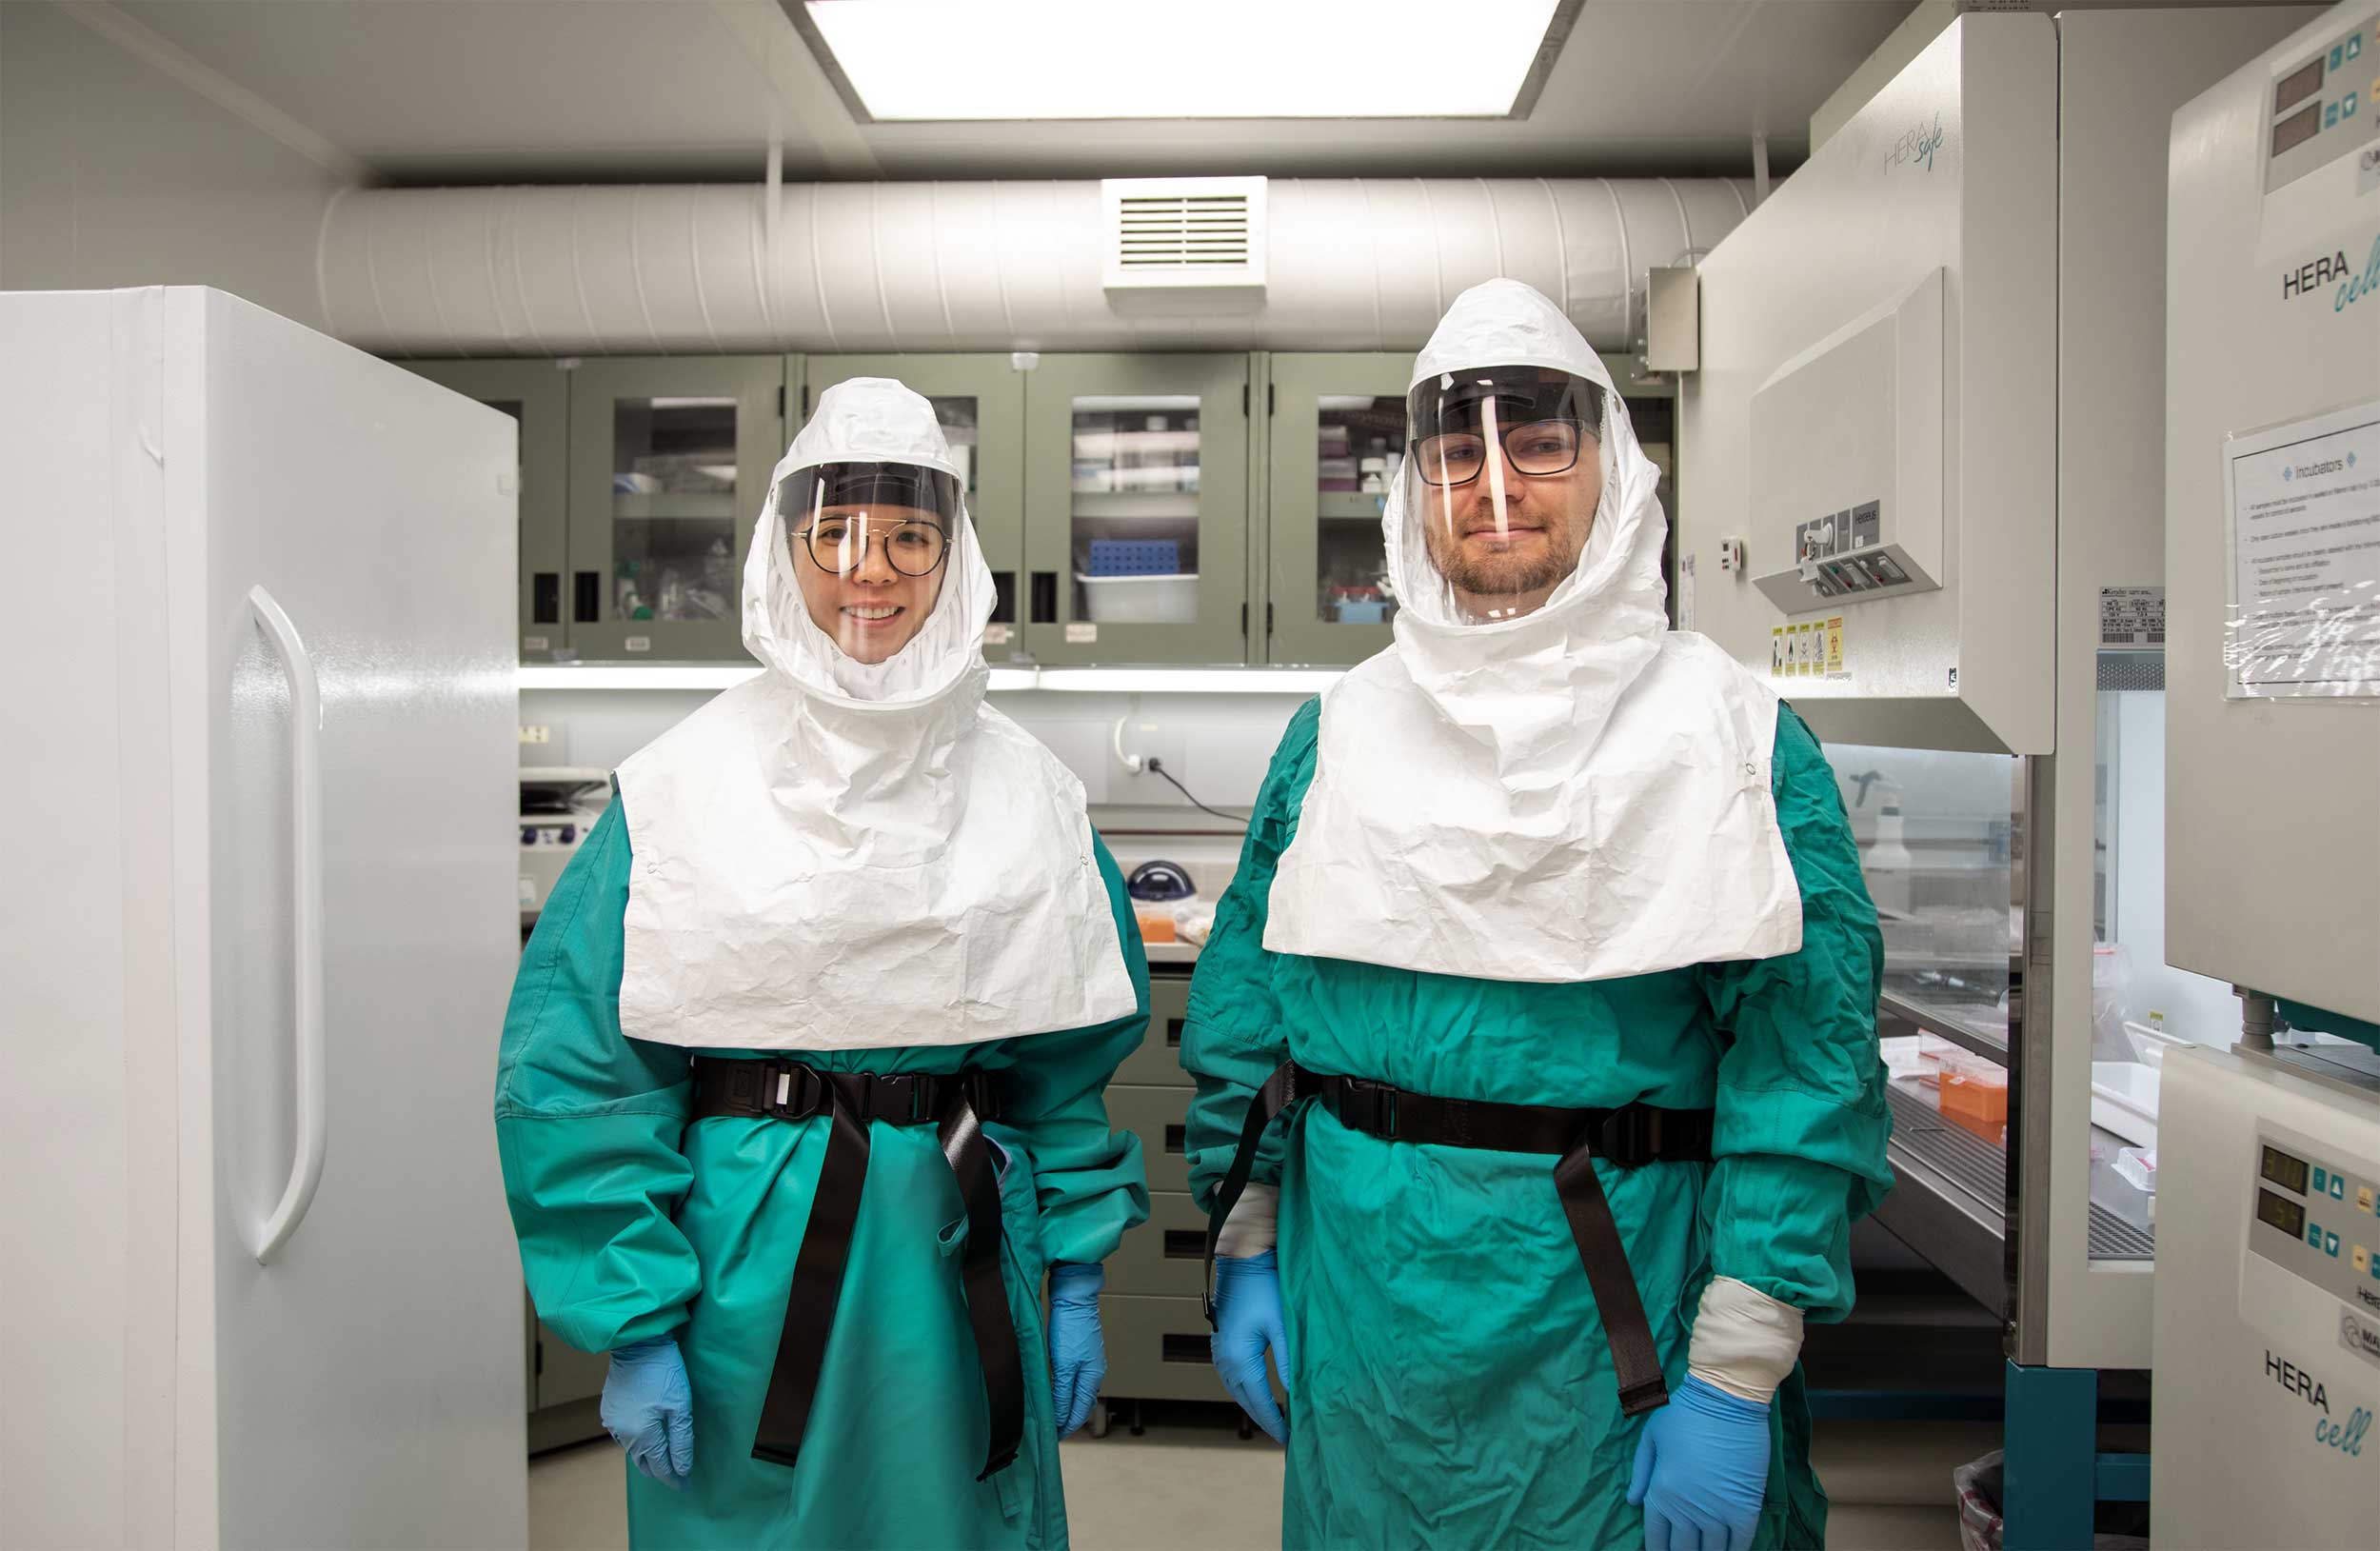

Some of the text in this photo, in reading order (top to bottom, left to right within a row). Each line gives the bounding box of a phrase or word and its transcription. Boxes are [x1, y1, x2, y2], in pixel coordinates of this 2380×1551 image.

[1884, 122, 1929, 176] HERA
[1913, 109, 1944, 172] safe
[2283, 250, 2350, 300] HERA
[2295, 458, 2344, 480] Incubators
[2265, 1348, 2330, 1416] HERA
[2314, 1406, 2372, 1457] cell
